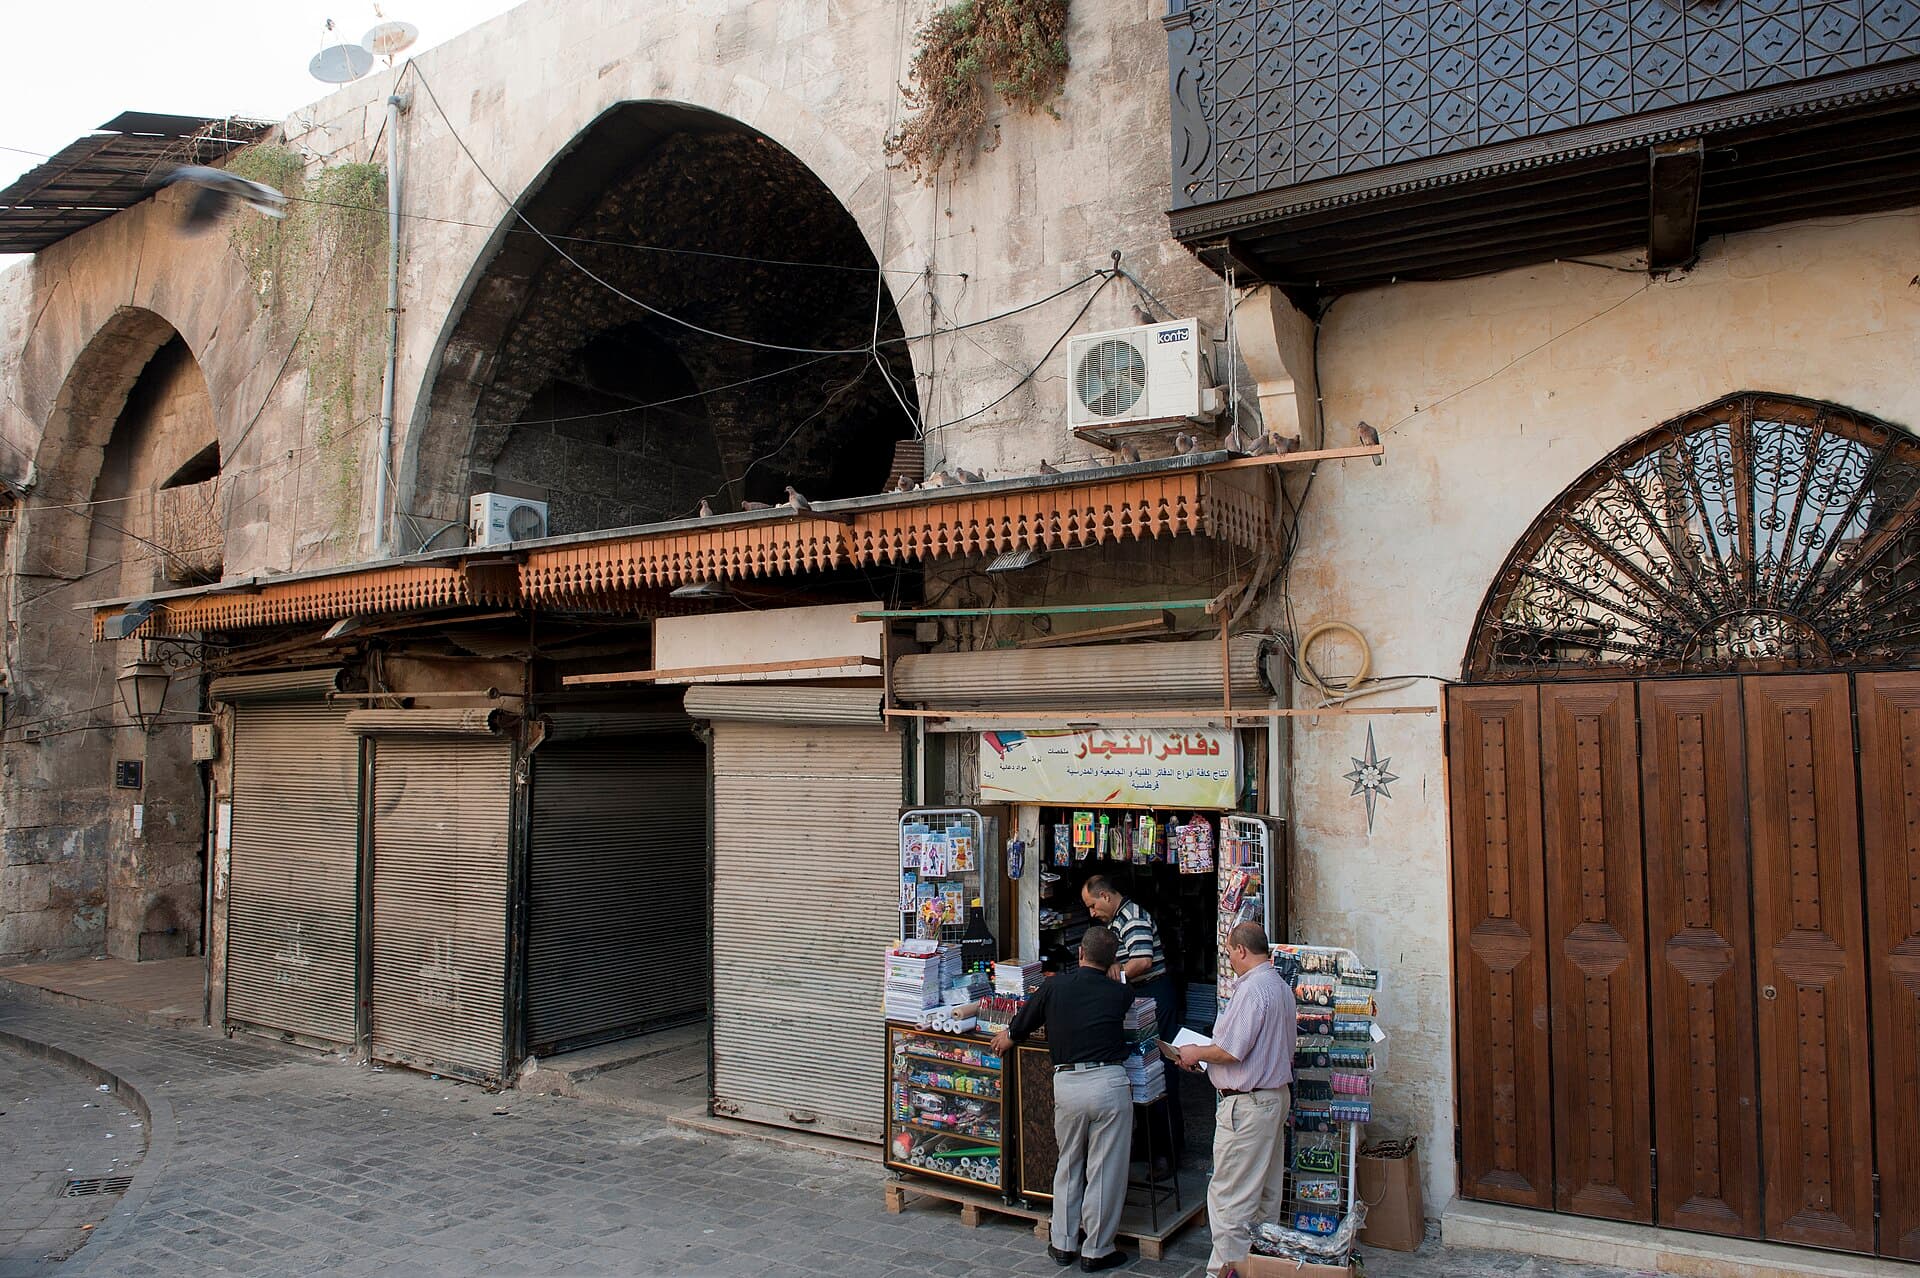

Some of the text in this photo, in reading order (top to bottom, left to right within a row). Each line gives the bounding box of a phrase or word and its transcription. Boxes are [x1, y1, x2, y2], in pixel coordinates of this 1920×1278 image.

[1075, 731, 1220, 760] دفاتر النجار
[1100, 766, 1126, 777] الجامعية
[1134, 767, 1152, 777] الفنية
[1155, 768, 1175, 777] الدفاتر
[1196, 768, 1211, 777] كافة
[1131, 779, 1160, 791] قرطاسية
